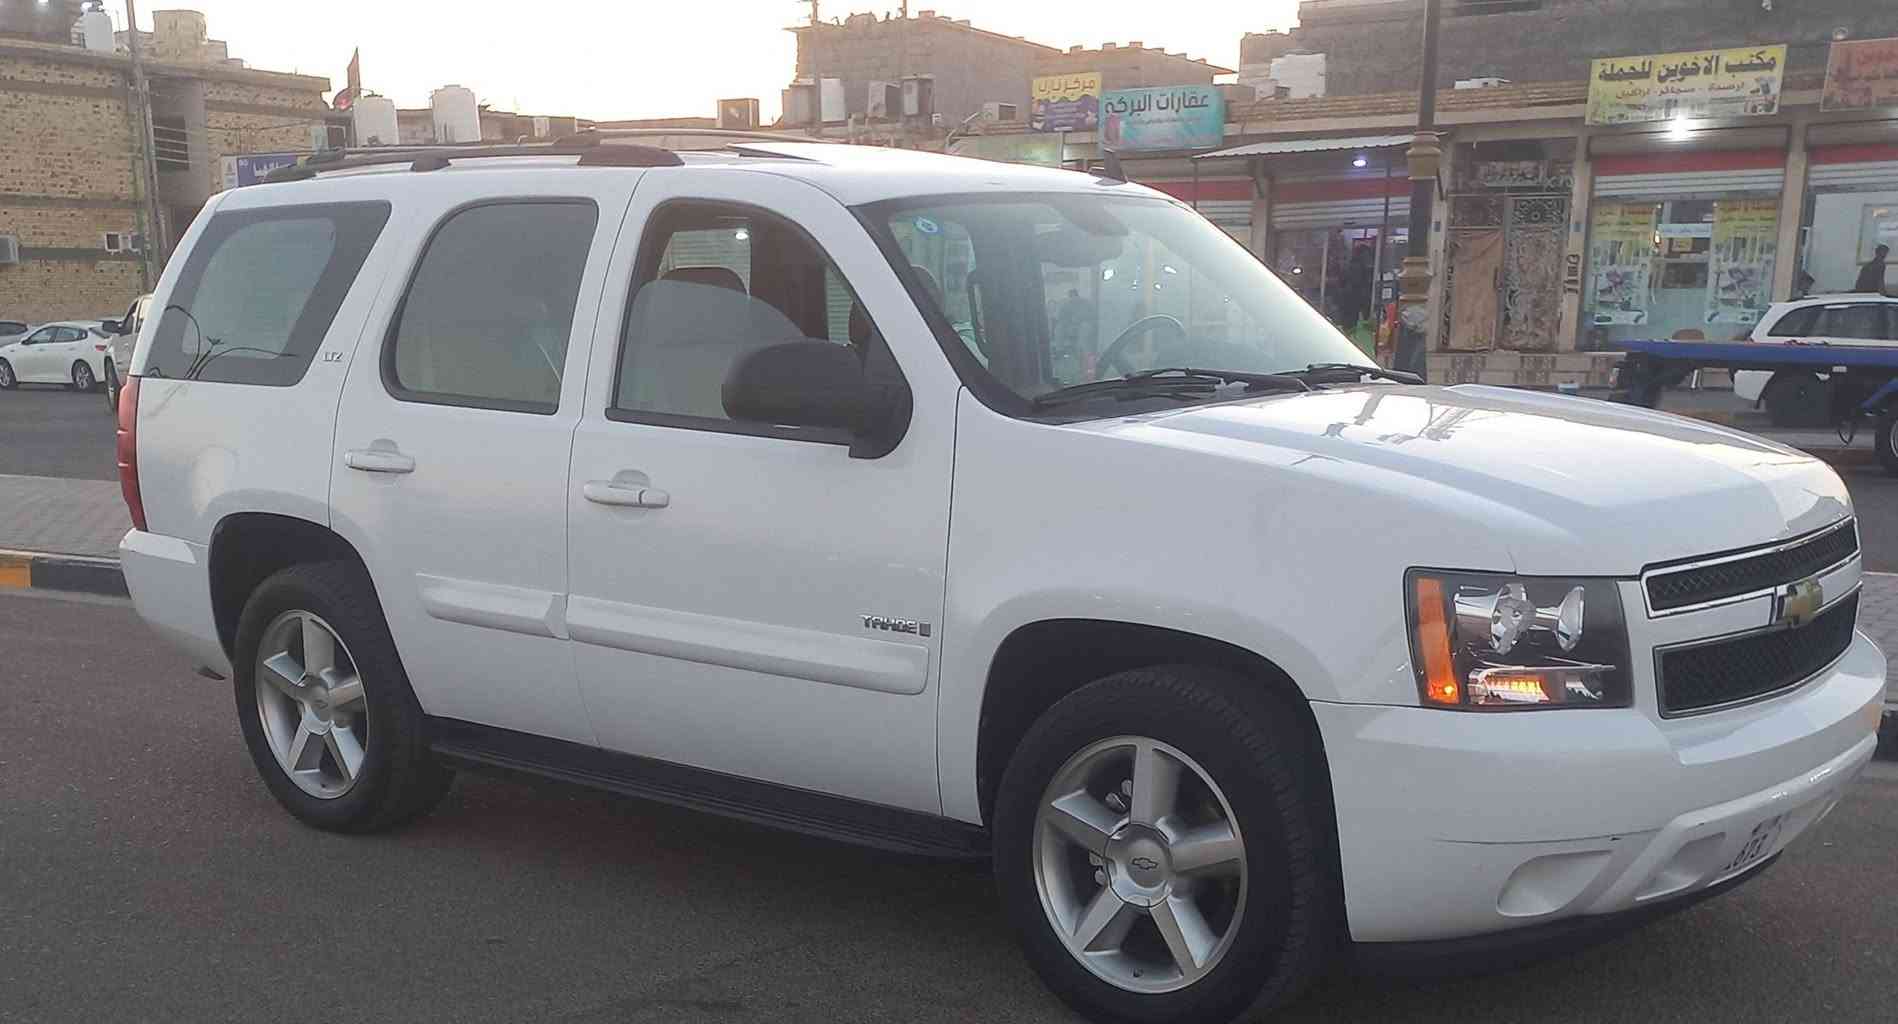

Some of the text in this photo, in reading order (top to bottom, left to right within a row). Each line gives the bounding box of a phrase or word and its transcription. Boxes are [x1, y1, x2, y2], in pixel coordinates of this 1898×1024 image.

[1598, 60, 1653, 85] للجملة
[1725, 50, 1777, 78] مكتب
[1155, 91, 1209, 114] عقارات
[323, 351, 344, 362] LTZ
[860, 614, 918, 635] TAHOE
